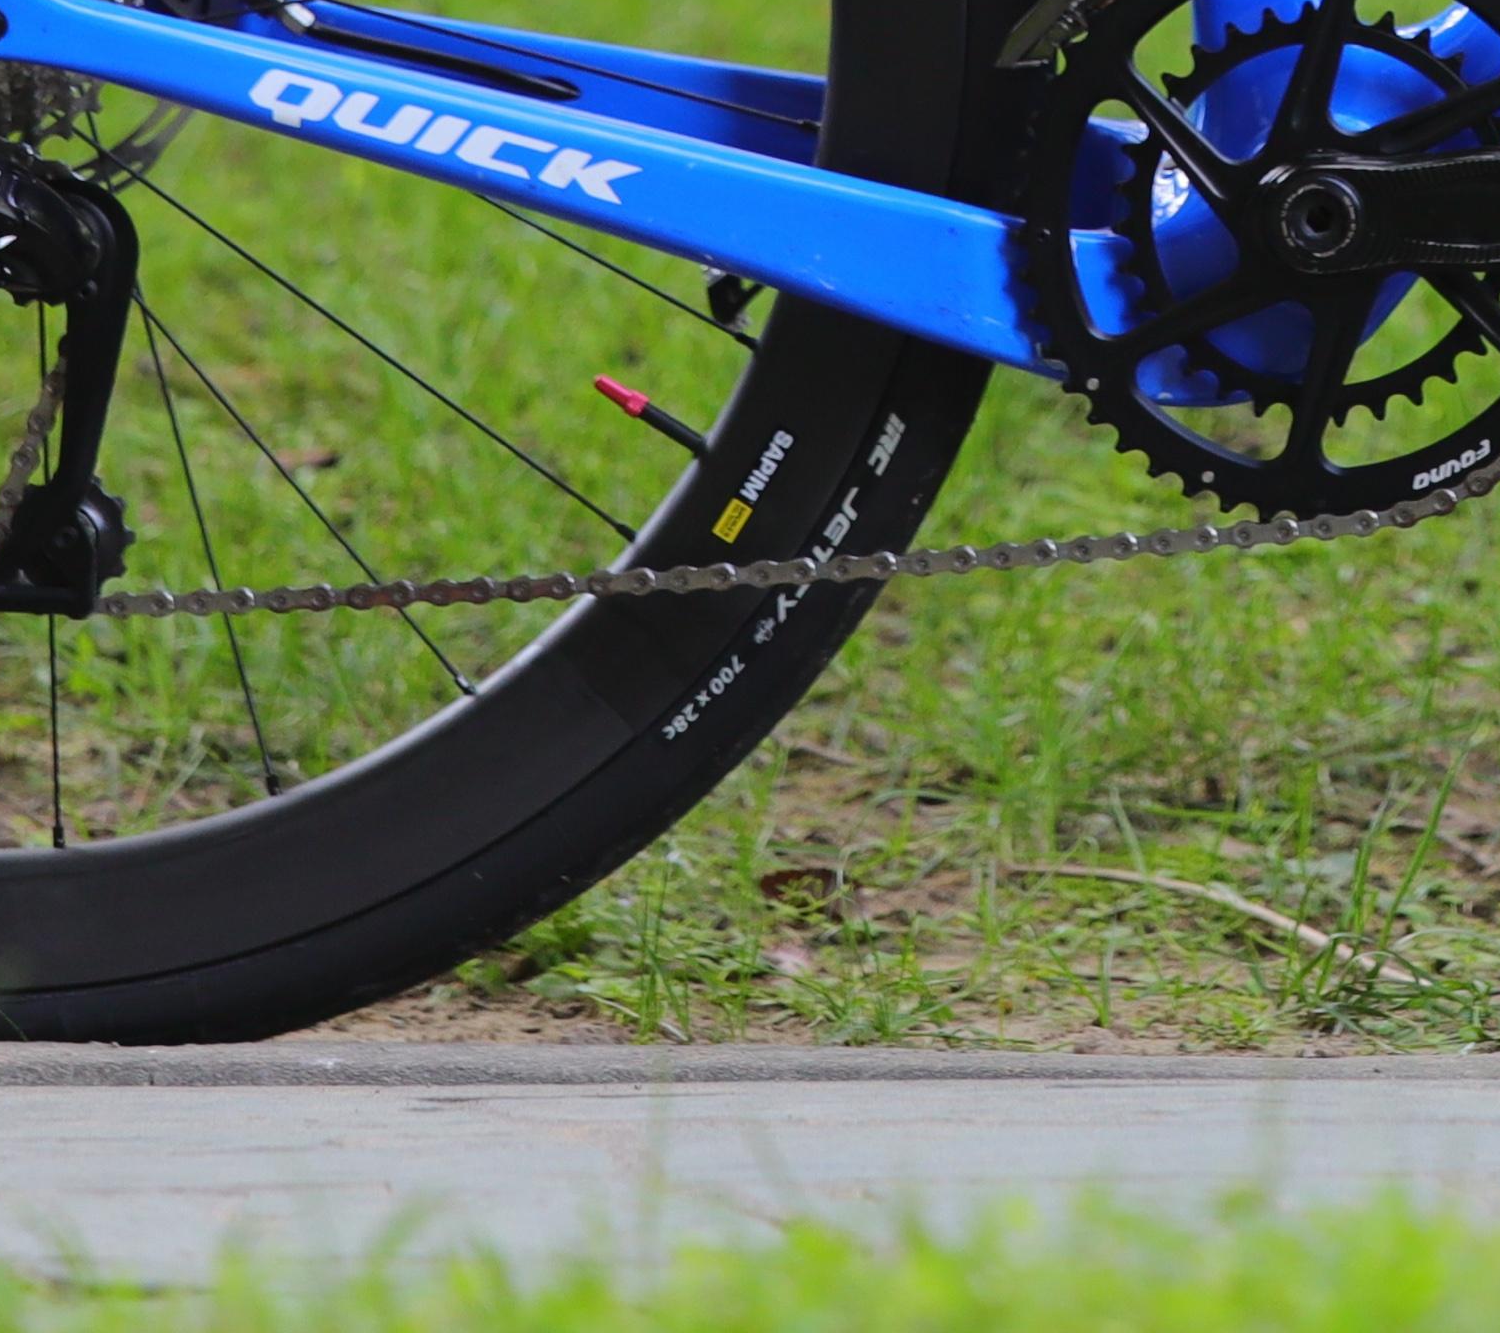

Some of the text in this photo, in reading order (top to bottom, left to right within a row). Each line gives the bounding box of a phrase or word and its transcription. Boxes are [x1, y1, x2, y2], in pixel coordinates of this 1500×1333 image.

[248, 68, 643, 205] QUICK
[738, 428, 795, 503] SAPIM
[710, 654, 746, 697] 700
